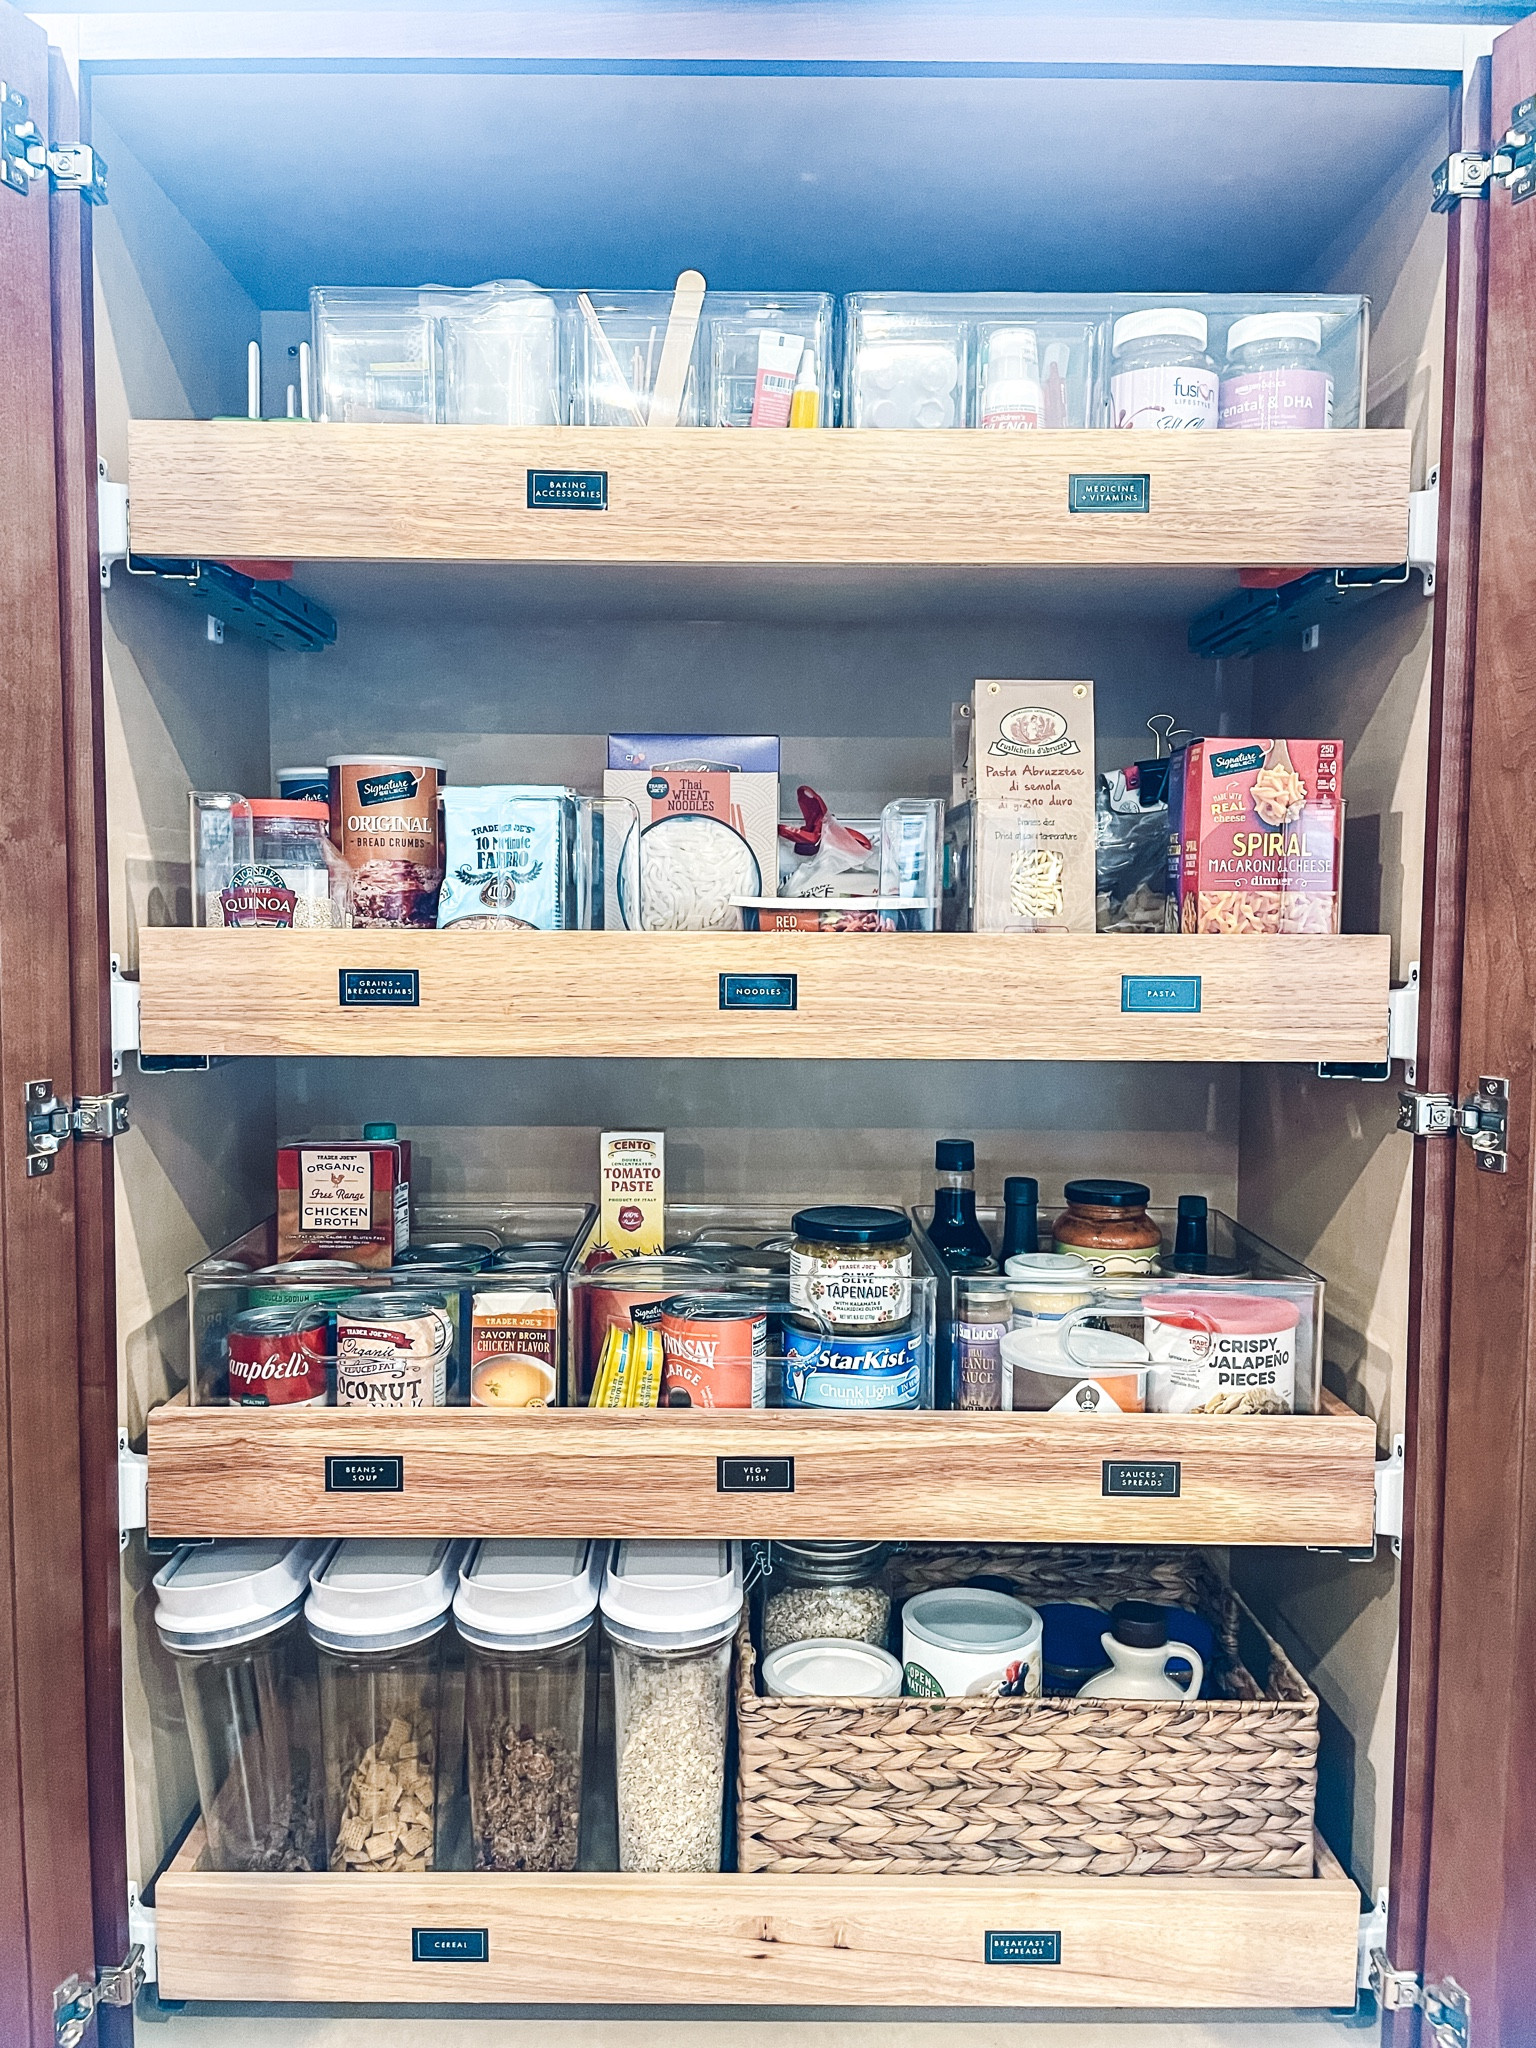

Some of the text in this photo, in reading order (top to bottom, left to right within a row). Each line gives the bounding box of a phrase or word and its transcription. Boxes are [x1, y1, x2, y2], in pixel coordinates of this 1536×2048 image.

[1284, 395, 1313, 409] DHA
[549, 481, 587, 489] BAKING
[1085, 485, 1135, 493] MEDICINE
[535, 490, 601, 498] ACCESSORIES
[1089, 494, 1138, 502] VITAMINS
[1320, 744, 1335, 754] 250
[1215, 752, 1257, 770] Signature
[986, 764, 1085, 778] Pasta Abruzzese
[364, 778, 409, 797] Signature
[680, 779, 703, 790] Thai
[1009, 779, 1061, 791] di semola
[672, 790, 711, 801] WHEAT
[1049, 794, 1073, 806] duro
[668, 801, 715, 811] NOODLES
[1210, 801, 1247, 816] REAL
[347, 815, 432, 834] ORIGINAL
[1213, 814, 1246, 824] cheese
[357, 838, 426, 848] BREAD CRUMBS
[475, 837, 490, 850] 10
[1231, 832, 1312, 857] SPIRAL
[1208, 859, 1275, 873] MACARONI
[1289, 859, 1333, 873] CHEESE
[1250, 876, 1293, 887] dinner
[225, 896, 291, 913] QUINOA
[776, 915, 798, 928] RED
[1147, 990, 1176, 998] PASTA
[614, 1141, 651, 1150] CENTO
[307, 1163, 365, 1174] ORGANIC
[604, 1167, 661, 1179] TOMATO
[611, 1181, 654, 1192] PASTE
[309, 1188, 365, 1201] Free Range
[304, 1207, 368, 1216] CHICKEN
[314, 1217, 359, 1226] BROTH
[825, 1282, 889, 1300] TAPENADE
[346, 1328, 367, 1336] TRADER
[480, 1331, 547, 1340] SAVORY BROTH
[972, 1326, 999, 1340] Luck
[343, 1339, 395, 1357] Organic
[477, 1341, 550, 1353] CHICKEN FLAVOR
[1219, 1337, 1278, 1353] CRISPY
[817, 1347, 907, 1371] StarKist
[1208, 1349, 1290, 1370] JALAPEÑO
[228, 1346, 309, 1385] ampbell's
[379, 1362, 396, 1370] FAT
[1218, 1371, 1276, 1386] PIECES
[338, 1376, 422, 1402] OCONUT
[820, 1383, 895, 1400] Chunk Light
[909, 1666, 932, 1689] OPEN
[434, 1941, 467, 1949] CEREAL
